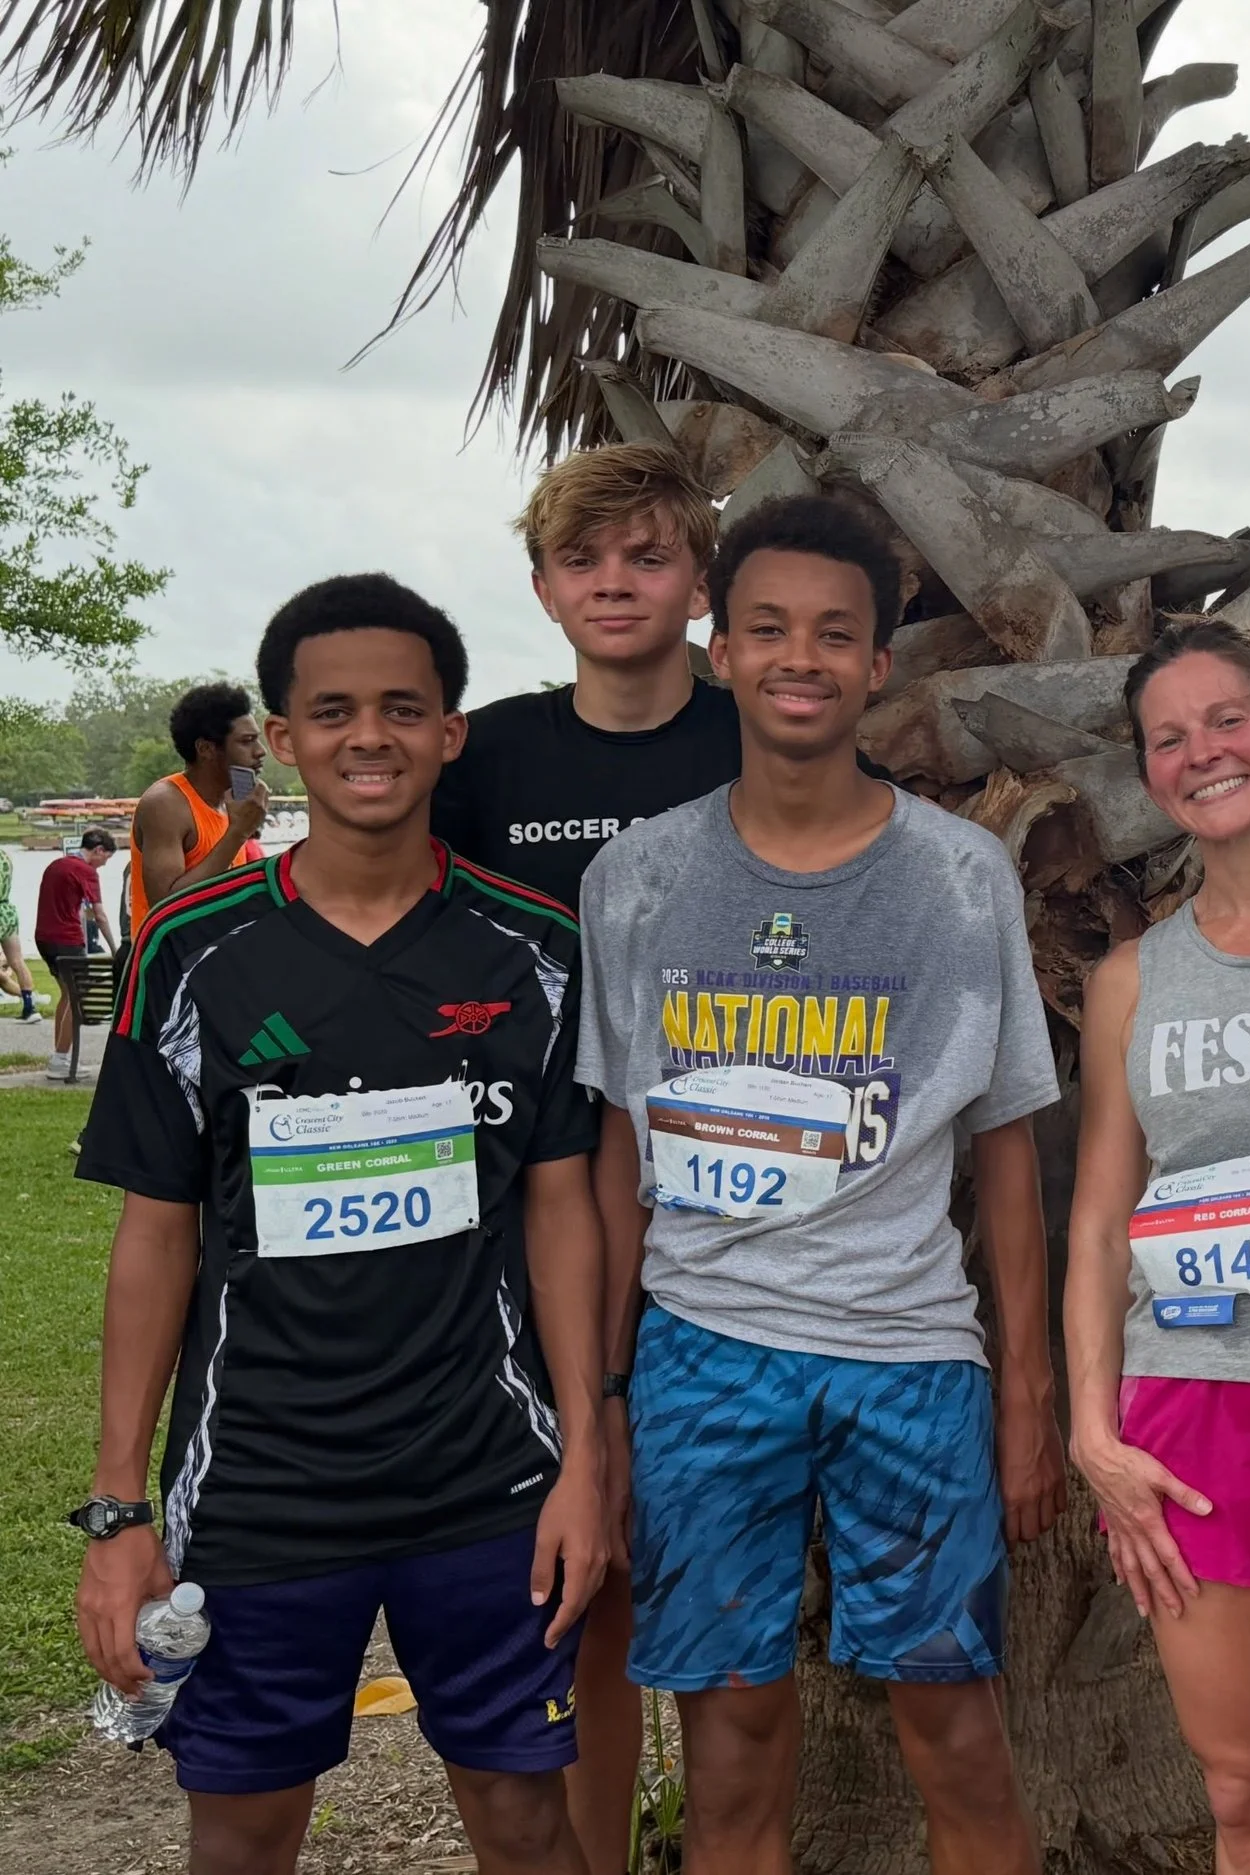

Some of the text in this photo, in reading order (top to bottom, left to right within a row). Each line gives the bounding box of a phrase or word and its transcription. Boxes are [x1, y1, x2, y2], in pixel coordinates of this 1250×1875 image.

[508, 817, 620, 845] SOCCER
[752, 946, 807, 956] WORLD SERIES
[764, 938, 797, 947] COLLEGE
[661, 968, 689, 985] 2025
[696, 970, 738, 988] NCAA
[743, 972, 810, 990] DIVISION
[830, 974, 908, 991] BASEBALL
[662, 990, 894, 1076] NATIONAL
[327, 1114, 344, 1123] City
[296, 1124, 332, 1134] Classic
[694, 1122, 781, 1142] BROWN CORRAL
[317, 1154, 411, 1172] GREEN CORRAL
[687, 1154, 787, 1206] 1192
[304, 1186, 431, 1240] 2520
[1193, 1212, 1216, 1222] RED
